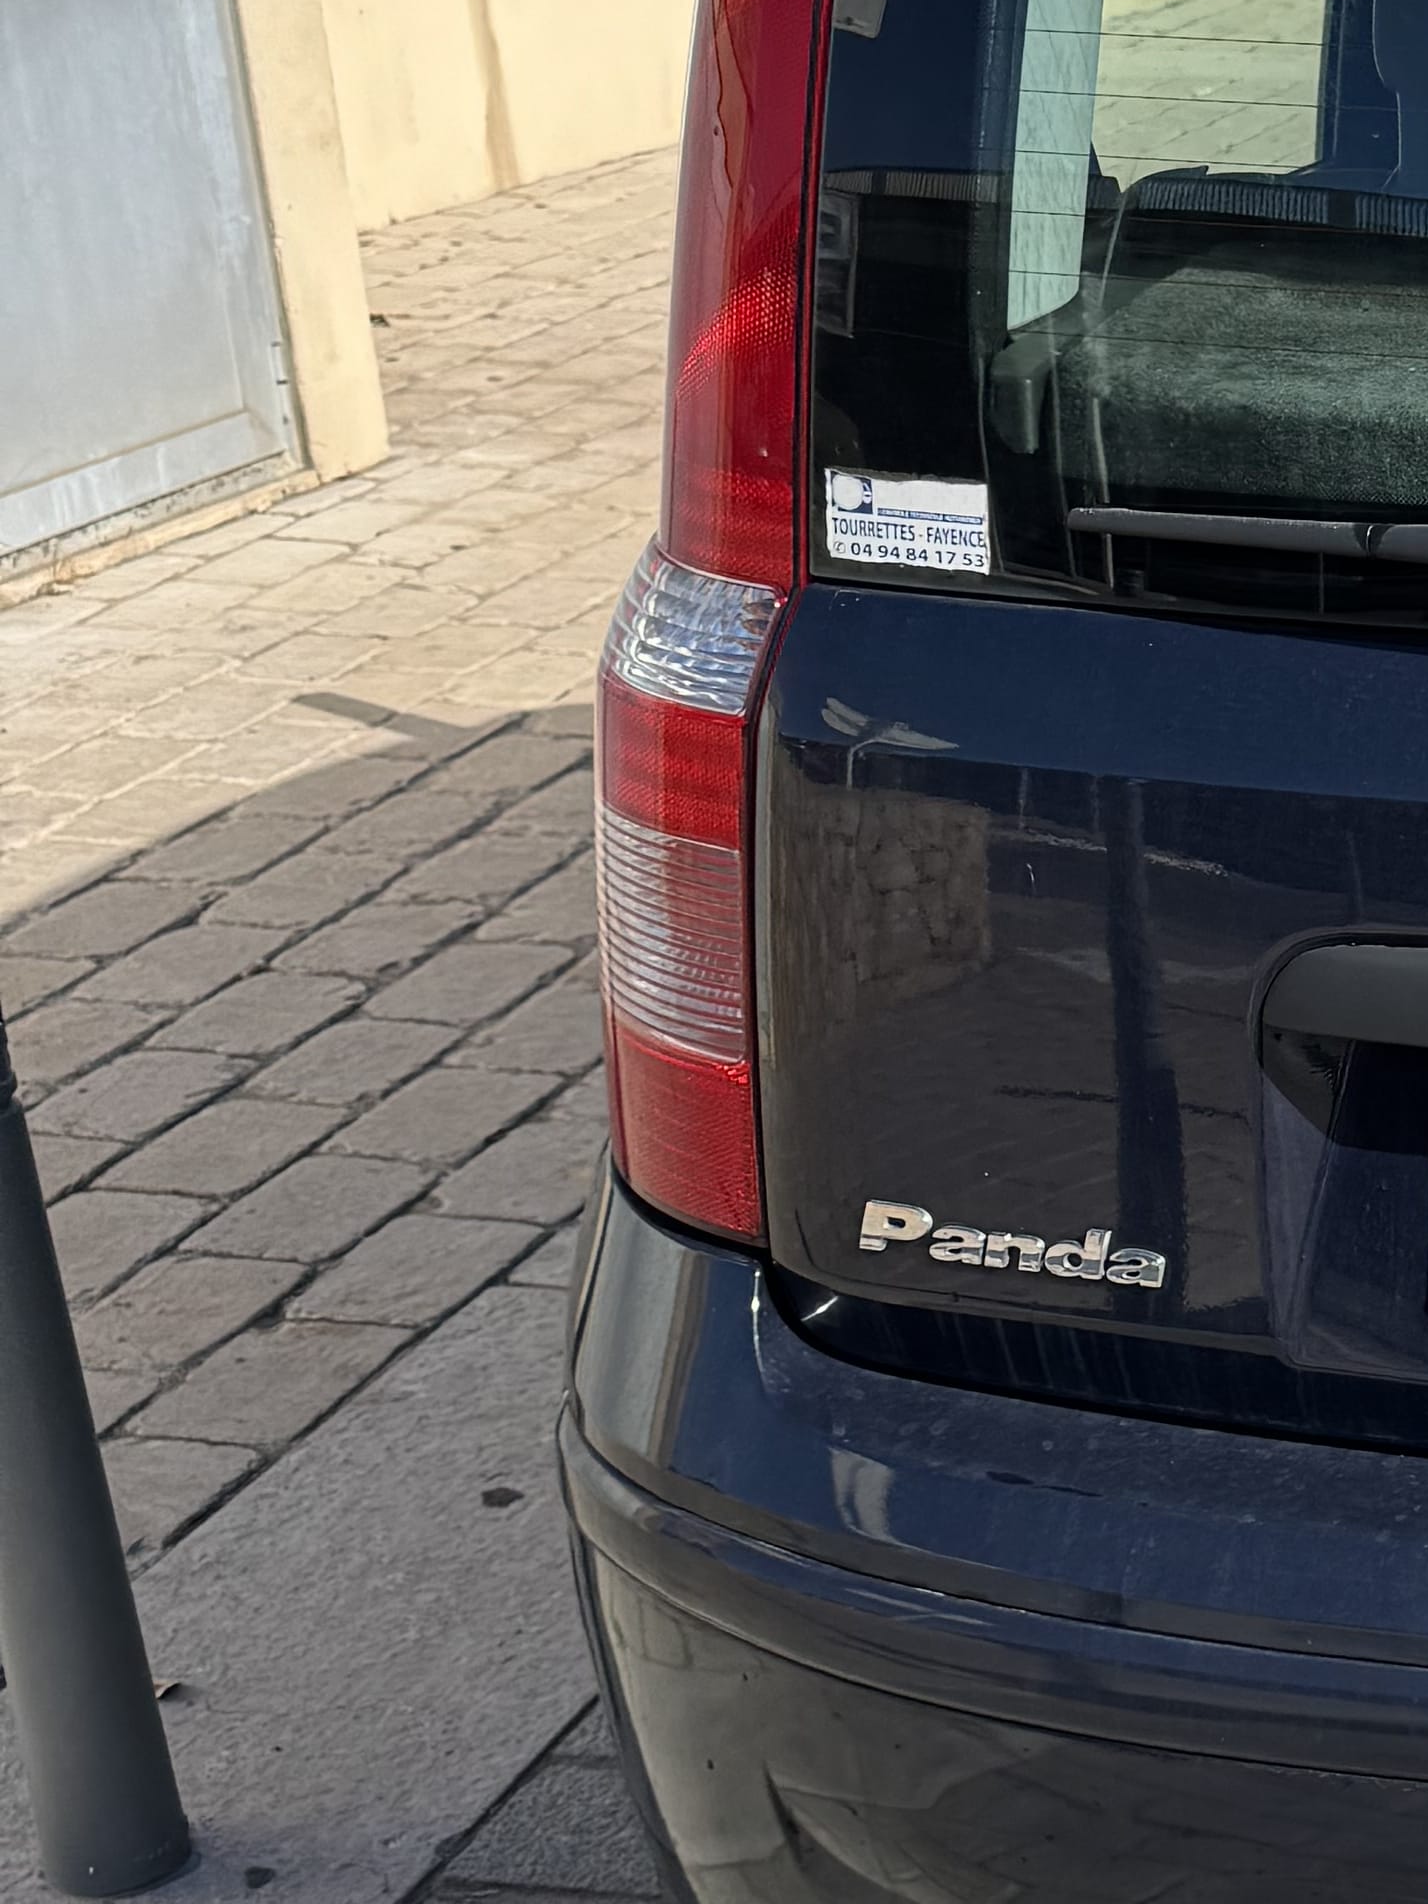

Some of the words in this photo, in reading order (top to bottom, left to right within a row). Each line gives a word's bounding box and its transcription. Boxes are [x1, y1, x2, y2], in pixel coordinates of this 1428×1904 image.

[832, 517, 915, 542] TOURRETTES
[927, 527, 986, 548] FAYENCE
[851, 542, 873, 557] 04
[877, 545, 900, 560] 94
[906, 548, 928, 562] 84
[935, 551, 956, 565] 17
[962, 554, 985, 567] 53
[859, 1199, 1167, 1289] Panda
